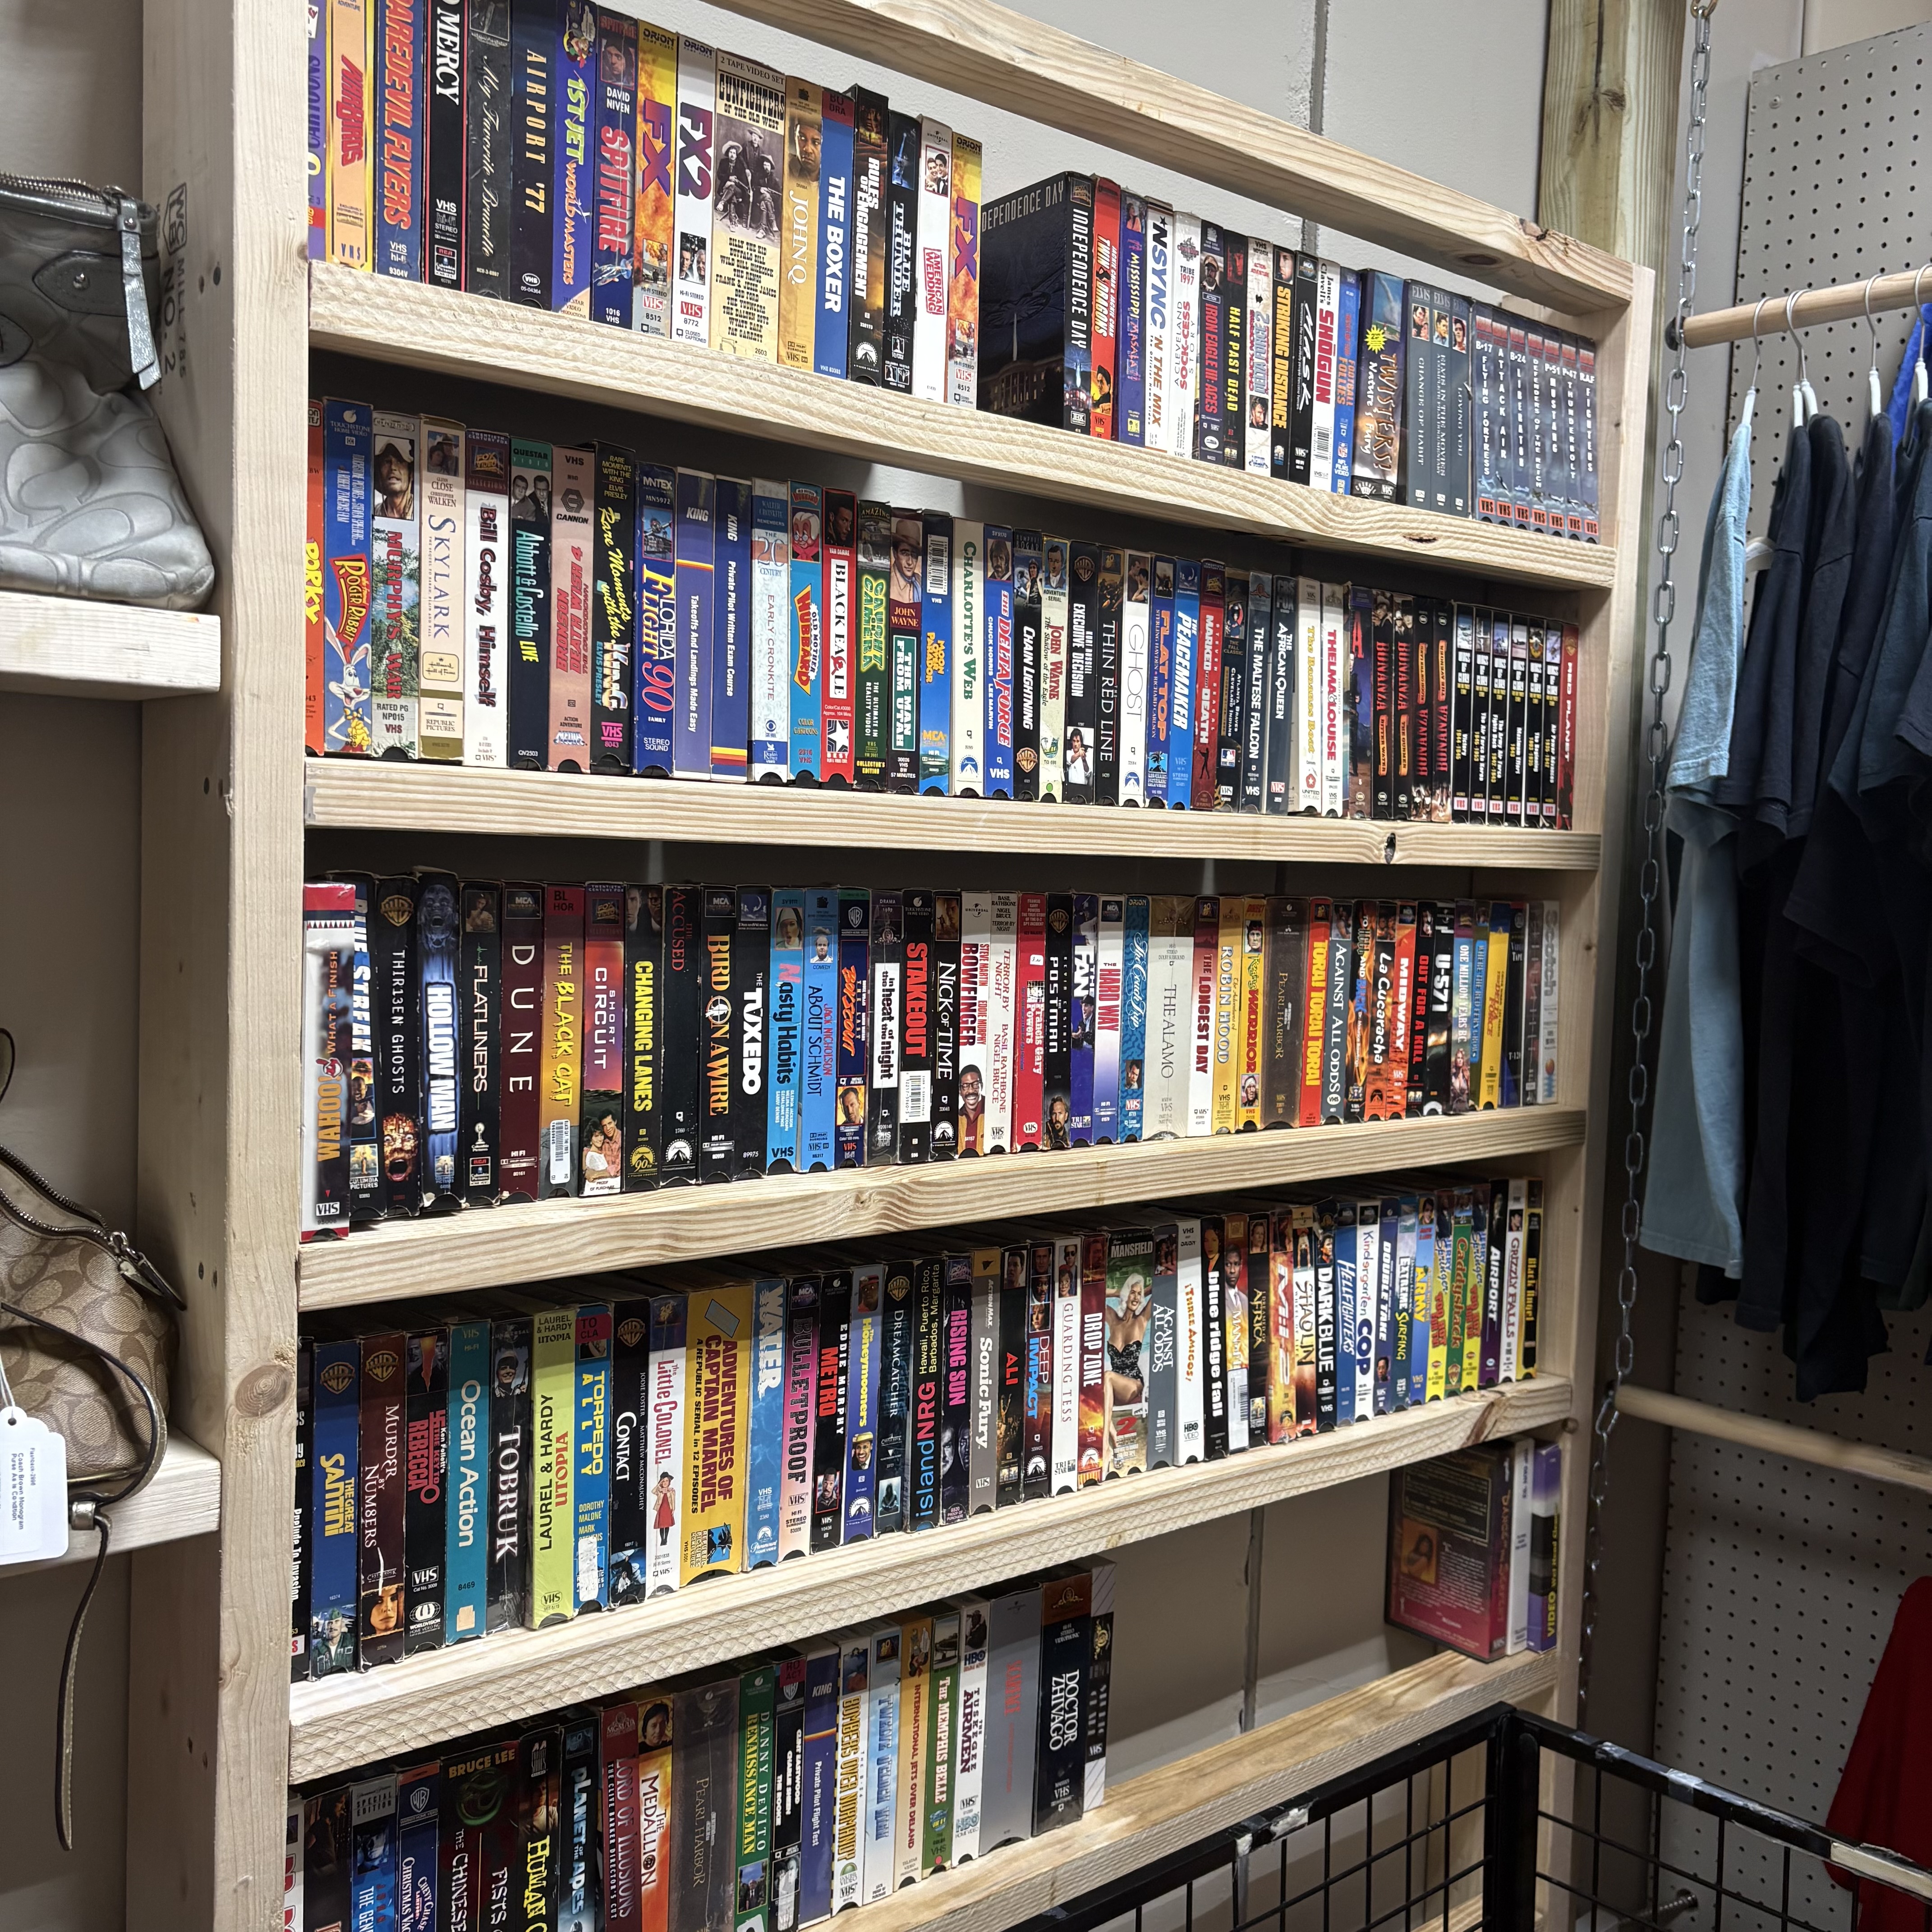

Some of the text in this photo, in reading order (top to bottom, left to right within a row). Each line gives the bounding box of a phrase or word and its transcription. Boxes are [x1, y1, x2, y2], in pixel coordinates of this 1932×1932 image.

[436, 7, 460, 105] MERCY
[607, 87, 630, 102] DAVID
[721, 55, 785, 85] 2 TAPE VIDEO SET
[525, 49, 547, 214] AIRPORT '77
[565, 118, 584, 165] JET
[607, 97, 630, 114] NIVEN
[384, 130, 413, 229] FLYERS
[599, 125, 632, 256] SPITFIRE
[866, 157, 880, 209] RULES
[789, 190, 809, 264] JOHN
[824, 176, 845, 313] THE BOXER
[855, 175, 869, 299] OF ENGAGEMENT
[891, 201, 904, 317] THUNDER
[902, 232, 911, 294] BLUE
[389, 267, 408, 278] 9304V
[605, 308, 620, 317] 1016
[925, 250, 935, 314] WEDDING
[933, 251, 944, 314] AMERICAN
[1071, 208, 1089, 349] INDEPENDENCE DAY
[1094, 235, 1111, 337] TWIN DRAGONS
[1127, 252, 1140, 319] MISSISSIPPI
[1180, 266, 1195, 276] TRIBE
[1180, 274, 1194, 285] 1997
[605, 314, 620, 324] VHS
[1227, 307, 1241, 411] HALF PAST DEAD
[1273, 286, 1291, 429] STRIKING DISTANCE
[432, 480, 453, 492] CLOSE
[514, 447, 548, 459] QUESTAR
[428, 496, 456, 507] WALKEN
[556, 513, 589, 525] CANNON
[686, 507, 708, 522] KING
[428, 514, 455, 639] SKYLARK
[476, 502, 497, 707] Bill Cosby, Himself
[658, 573, 676, 660] FLORIDA
[691, 595, 699, 630] Takeoffs
[895, 607, 915, 617] JOHN
[727, 561, 736, 696] Private Pilot Written Exam Course
[767, 595, 775, 700] EARLY CRONKITE
[892, 615, 919, 627] WAYNE
[964, 541, 978, 700] CHARLOTTE'S WEB
[1071, 603, 1085, 697] EXECUTIVE DECISION
[377, 704, 395, 712] RATED
[594, 642, 603, 705] ELVIS PRESLEY
[641, 662, 674, 712] 90
[689, 688, 698, 711] Made
[690, 649, 698, 686] Landings
[1023, 626, 1035, 730] CHAIN LIGHTNING
[1100, 621, 1116, 762] THIN RED LINE
[1126, 624, 1145, 722] GHOST
[1173, 611, 1191, 730] PEACEMAKER
[1250, 628, 1264, 759] THE MALTESE FALCON
[382, 712, 405, 721] NP015
[689, 713, 698, 732] Easy
[990, 768, 1009, 778] VHS
[509, 945, 535, 1093] DUNE
[594, 967, 606, 1069] CIRCUIT
[906, 943, 928, 1058] STAKEOUT
[937, 961, 956, 1080] NICK OF TIME
[960, 943, 979, 1046] BOWFINGER
[1098, 968, 1121, 1032] HARD WAY
[1329, 943, 1347, 1091] AGAINST ALL ODDS
[1396, 957, 1409, 1051] MIDWAY
[1432, 953, 1451, 1012] U-571
[428, 987, 455, 1130] HOLLOW MAN
[473, 965, 488, 1092] FLATLINERS
[634, 960, 653, 1112] CHANGING LANES
[823, 1004, 834, 1076] JACK NICHOLSON
[1161, 1019, 1177, 1078] ALAMO
[1196, 976, 1211, 1074] LONGEST DAY
[318, 1076, 343, 1162] WAHOO!
[1111, 1242, 1153, 1258] MANSFIELD
[1488, 1246, 1501, 1322] AIRPORT
[1317, 1265, 1334, 1371] DARK BLUE
[1337, 1260, 1356, 1356] HELLFIGHTERS
[1357, 1231, 1374, 1375] Kindergarten COP
[1451, 1237, 1468, 1348] Caddyshack
[788, 1319, 813, 1484] BULLETPROOF
[819, 1347, 838, 1417] METRO
[890, 1310, 904, 1418] DREAMCATCHER
[975, 1337, 993, 1449] Sonic Fury
[1005, 1352, 1018, 1385] ALI
[1027, 1338, 1040, 1420] IMPACT
[1040, 1336, 1049, 1384] DEEP
[1061, 1303, 1073, 1422] GUARDING TESS
[458, 1380, 481, 1547] Ocean Action
[591, 1371, 605, 1475] TORPEDO
[616, 1411, 637, 1481] CONTACT
[700, 1334, 722, 1513] CAPTAIN MARVEL
[496, 1425, 520, 1563] TOBRUK
[555, 1431, 568, 1507] UTOPIA
[579, 1500, 604, 1511] DOROTHY
[579, 1510, 601, 1523] MALONE
[458, 1580, 475, 1591] 8469
[812, 1682, 832, 1697] KING
[971, 1688, 980, 1771] TUSKEGEE
[1049, 1674, 1064, 1751] ZHIVAGO
[1064, 1670, 1079, 1747] DOCTOR
[448, 1751, 515, 1778] BRUCE LEE
[960, 1690, 975, 1774] AIRMEN
[742, 1714, 758, 1854] RENAISSANCE MAN
[757, 1711, 769, 1850] DANNY DEVITO
